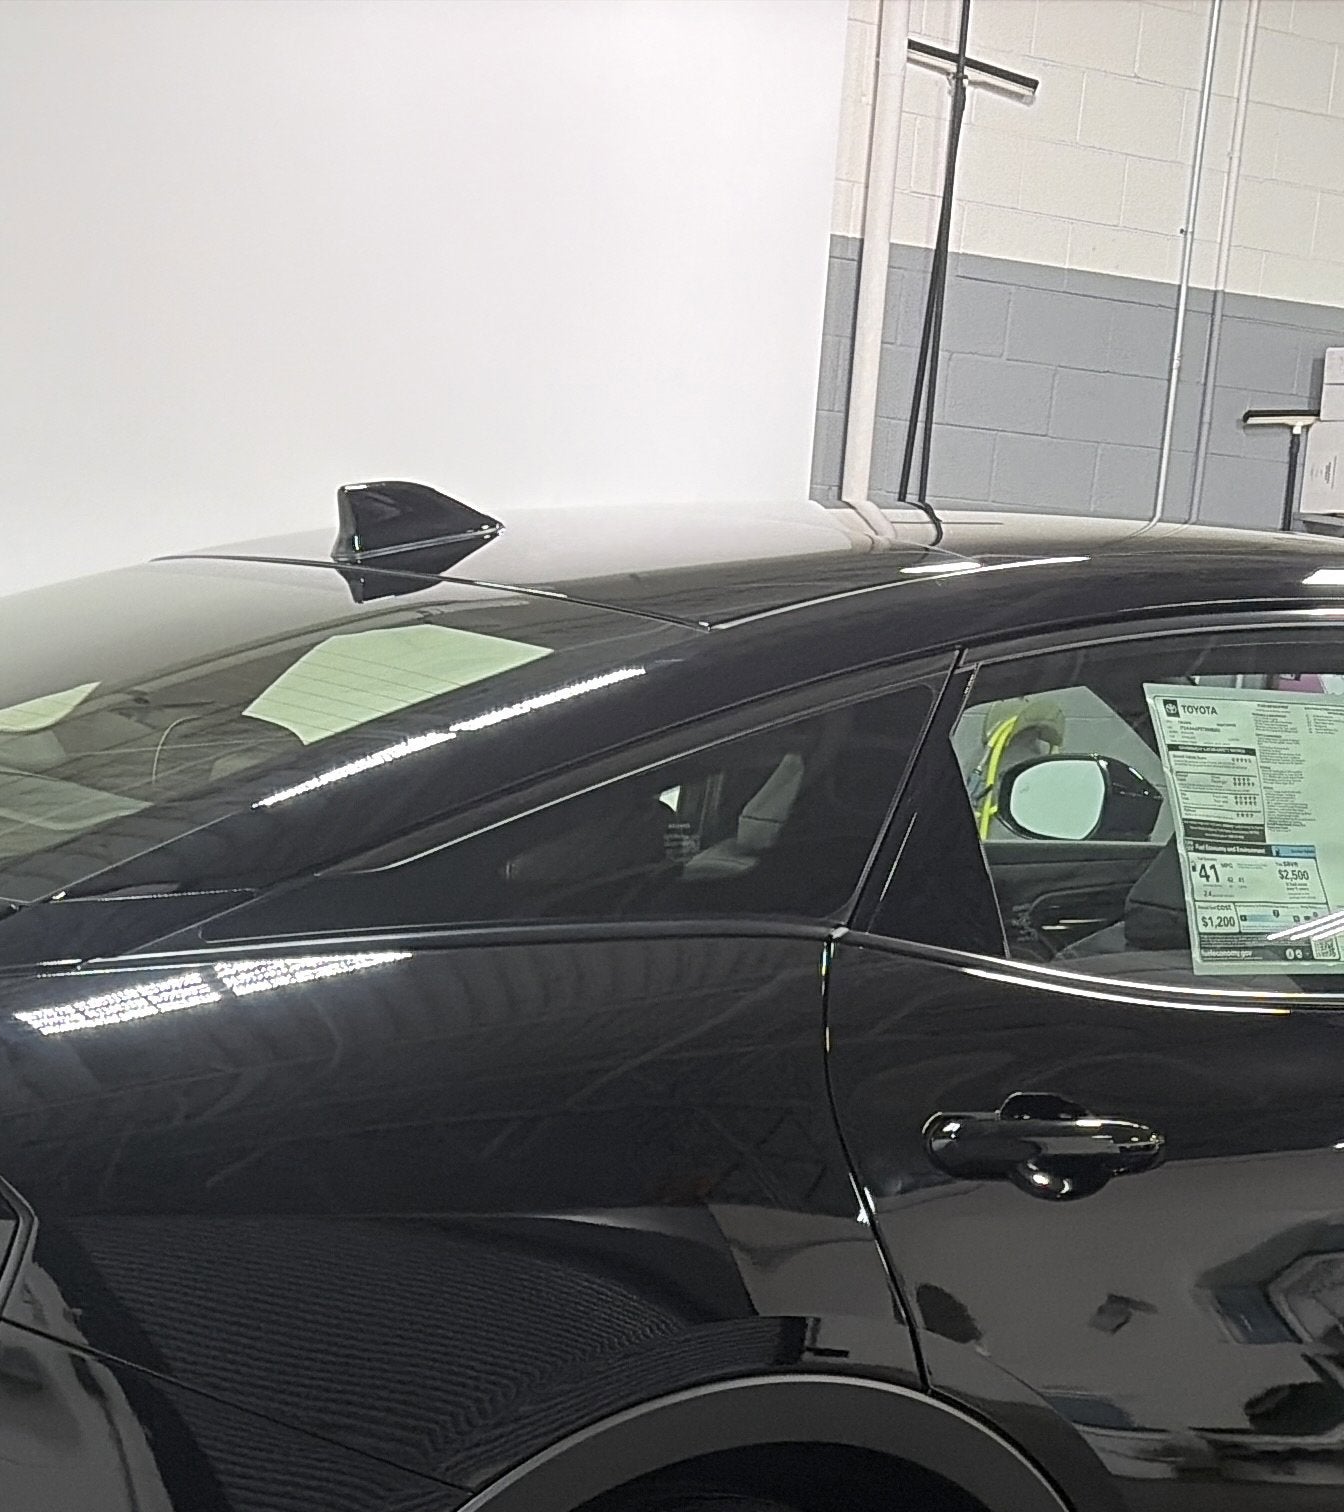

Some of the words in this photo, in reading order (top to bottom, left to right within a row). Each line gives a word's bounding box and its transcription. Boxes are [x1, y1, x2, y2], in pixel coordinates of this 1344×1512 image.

[1181, 704, 1218, 715] TOYOTA
[1198, 863, 1220, 883] 41
[1278, 869, 1310, 882] $2,500
[1201, 915, 1236, 929] $1,200
